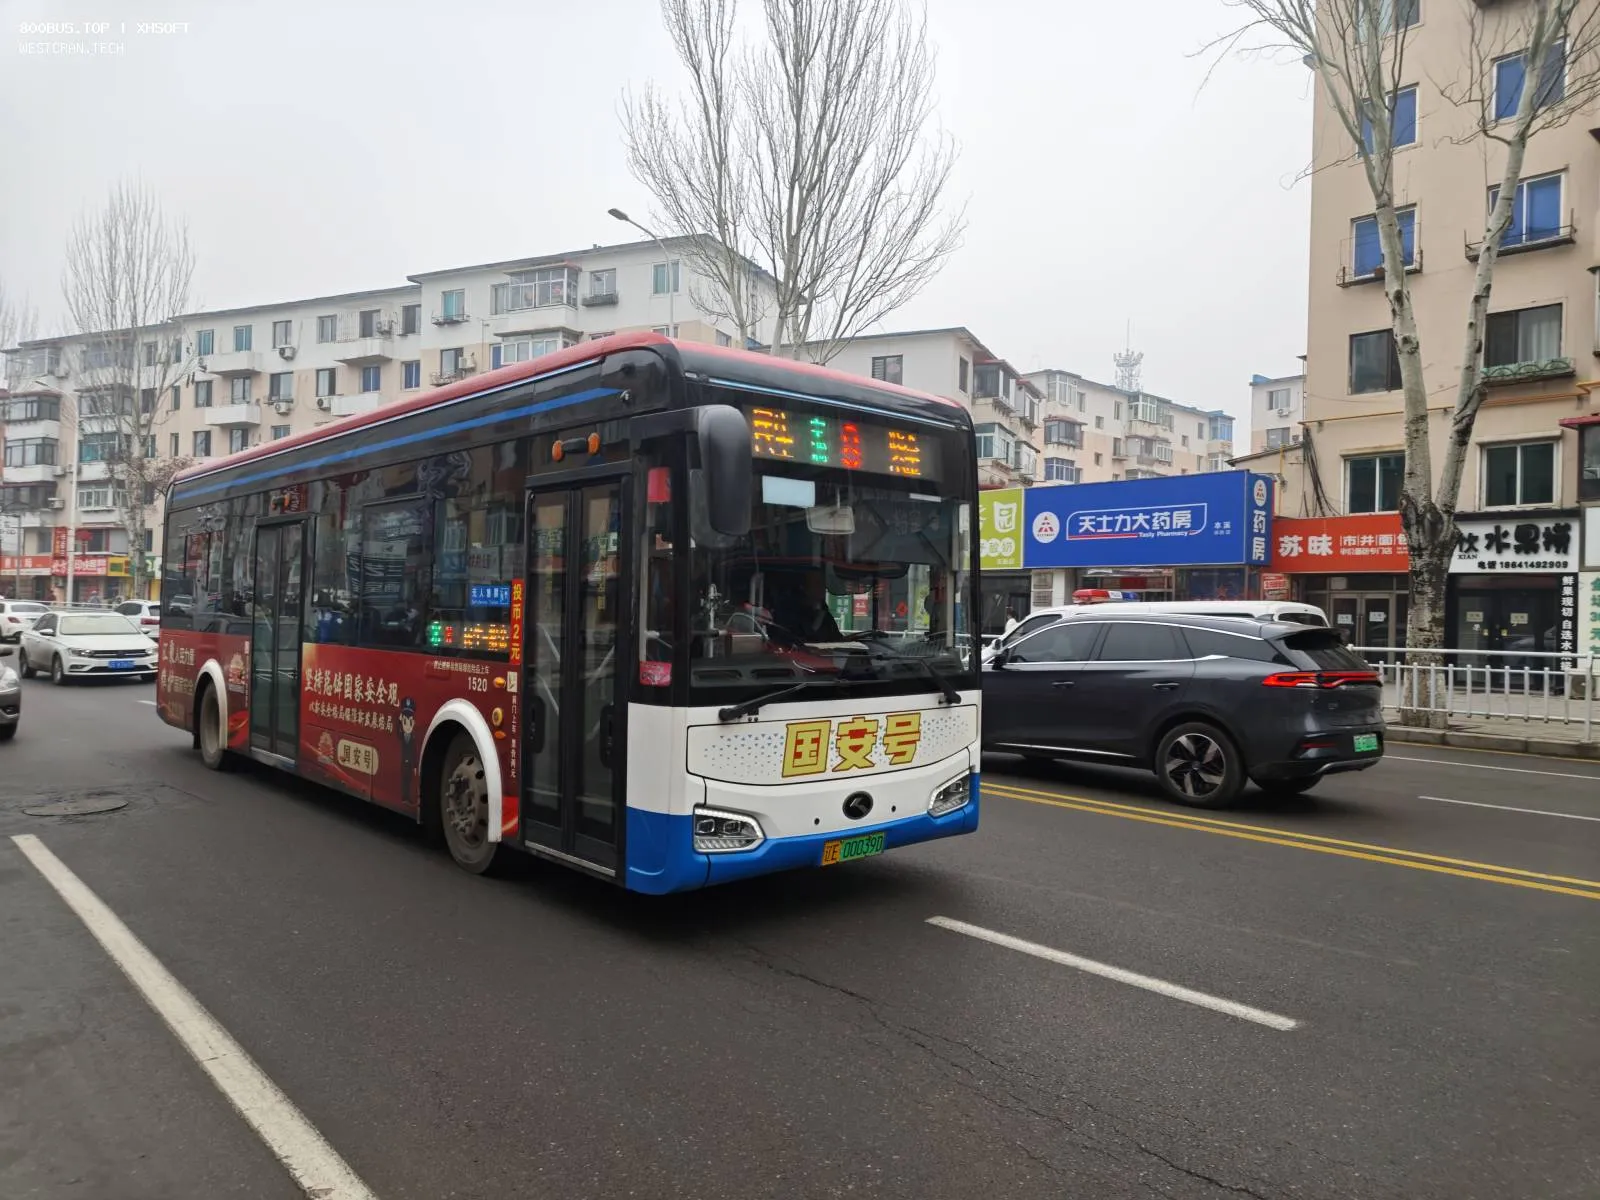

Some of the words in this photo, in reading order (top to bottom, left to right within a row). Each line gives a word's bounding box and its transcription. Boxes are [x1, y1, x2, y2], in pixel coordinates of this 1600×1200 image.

[1079, 510, 1192, 533] 天士力大药房
[1157, 530, 1188, 538] Pharmacy
[1252, 510, 1266, 561] 药房
[1279, 534, 1333, 557] 苏味
[1478, 561, 1496, 569] 电话
[512, 583, 522, 660] 投币2元
[468, 676, 488, 692] 1520
[343, 744, 371, 769] 国安号
[782, 713, 922, 778] 国安号
